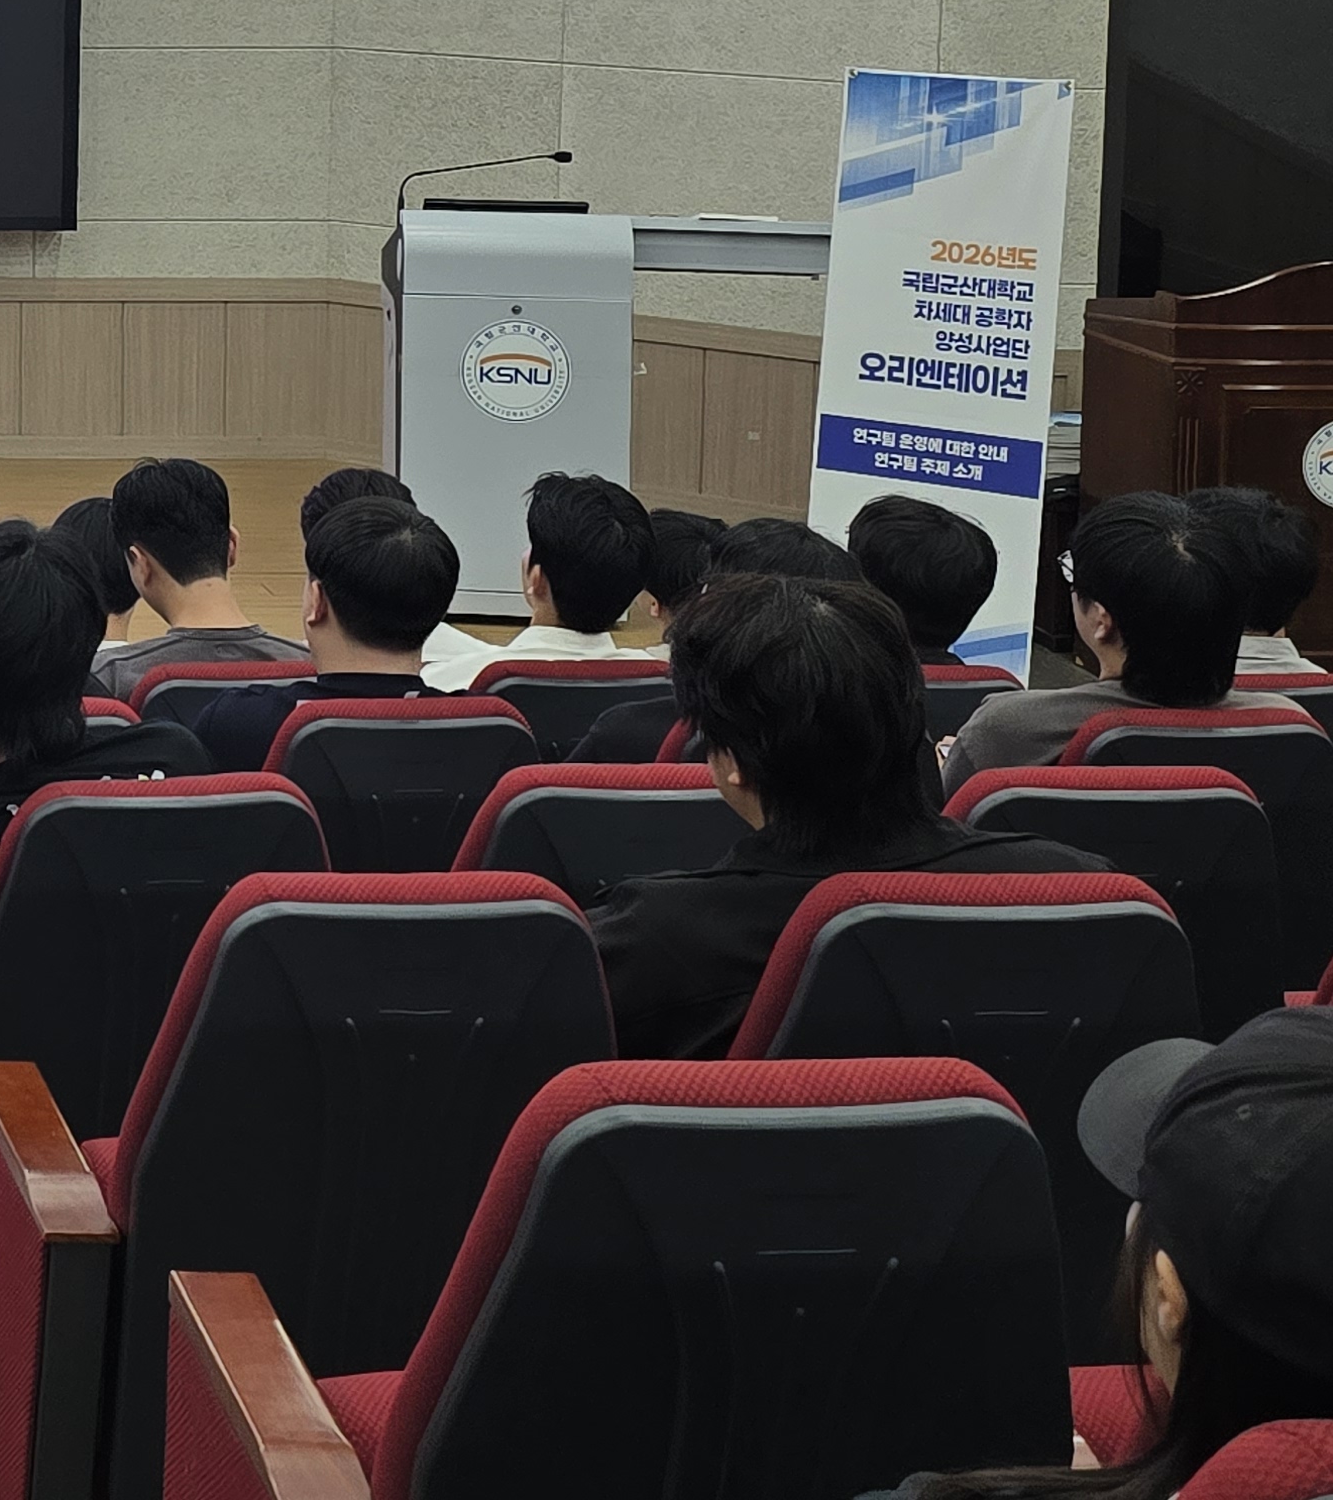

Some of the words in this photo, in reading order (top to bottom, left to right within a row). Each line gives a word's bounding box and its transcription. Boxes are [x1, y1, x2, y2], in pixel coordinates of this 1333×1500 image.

[931, 240, 1038, 270] 2026년도
[902, 270, 1034, 303] 국립군산대학교
[914, 300, 971, 326] 차세대
[976, 305, 1032, 332] 공학자
[935, 330, 1030, 360] 양성사업단
[480, 364, 551, 384] KSNU
[858, 352, 1028, 400] 오리엔테이션
[853, 427, 896, 448] 연구팀
[945, 440, 976, 458] 대한
[978, 444, 1009, 463] 안내
[875, 451, 918, 471] 연구팀
[921, 458, 950, 477] 주제
[952, 463, 982, 481] 소개
